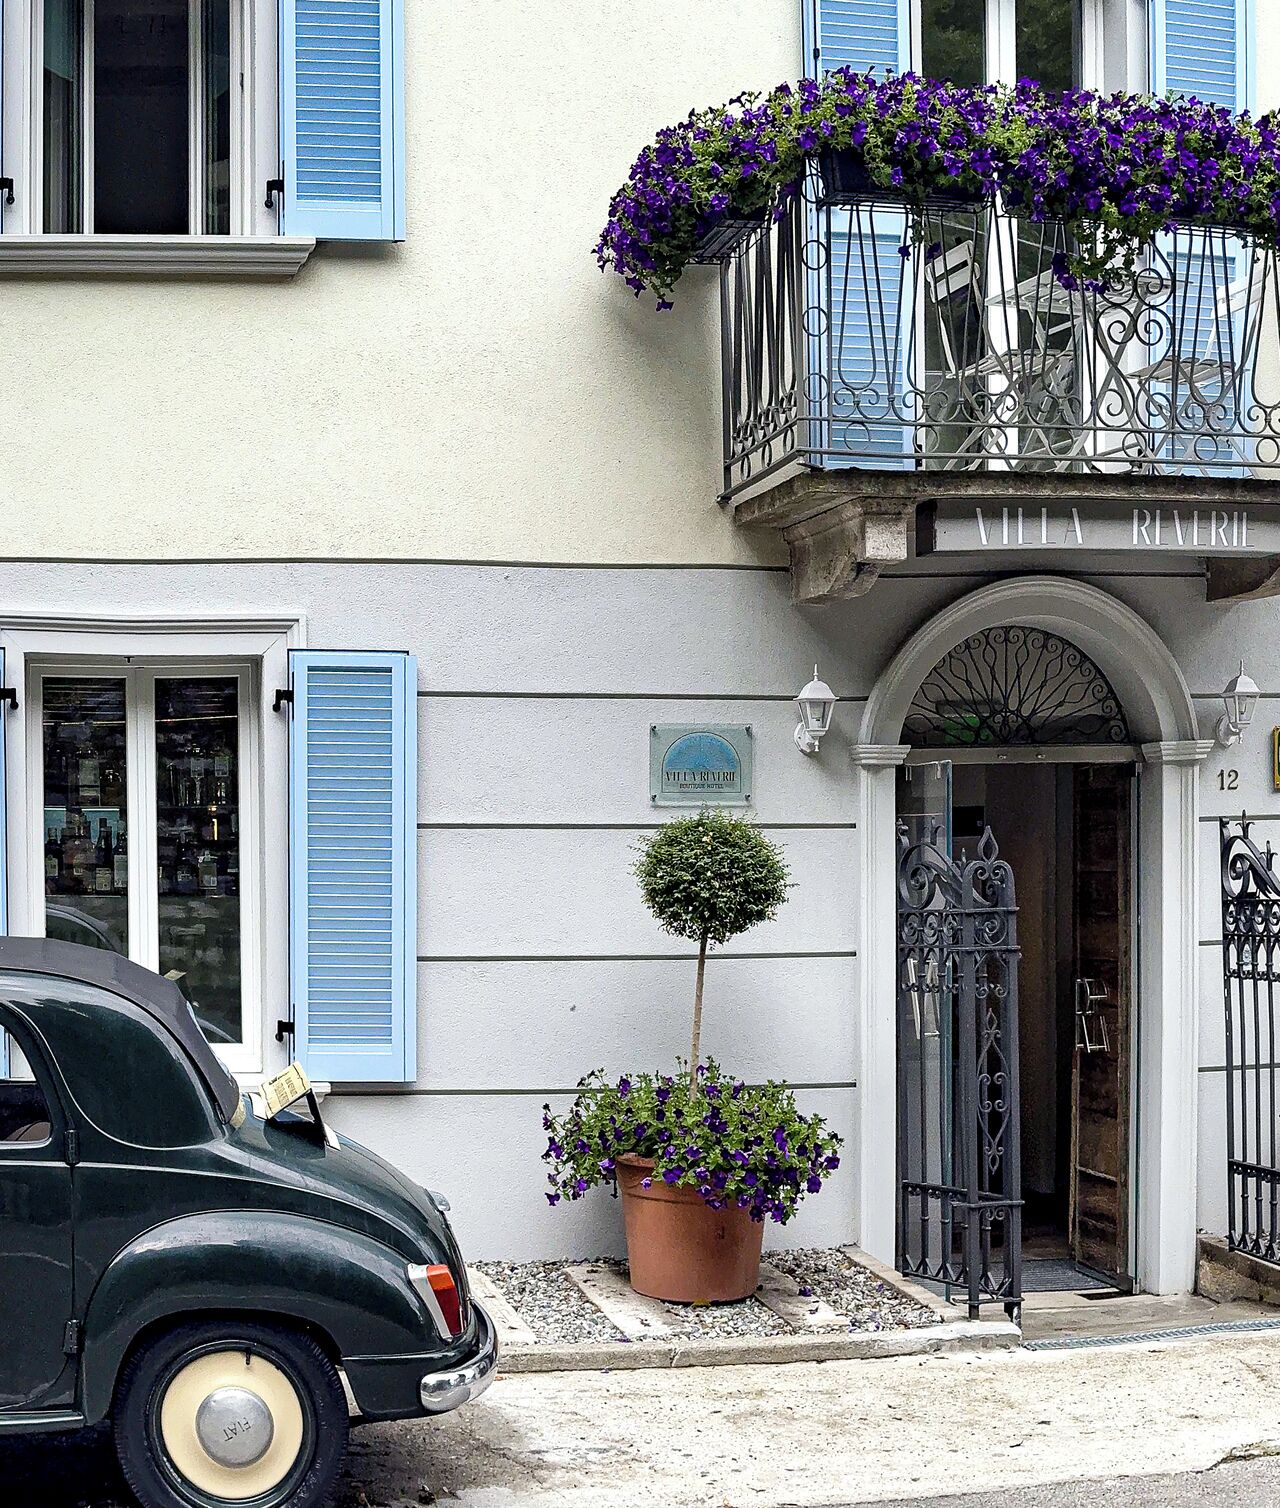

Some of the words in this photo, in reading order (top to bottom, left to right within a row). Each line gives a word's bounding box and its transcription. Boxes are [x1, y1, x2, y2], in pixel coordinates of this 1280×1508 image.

[976, 507, 1083, 545] VILLA
[1132, 509, 1255, 547] REVERIE
[1217, 769, 1239, 791] 12
[222, 1417, 252, 1442] FIAT
